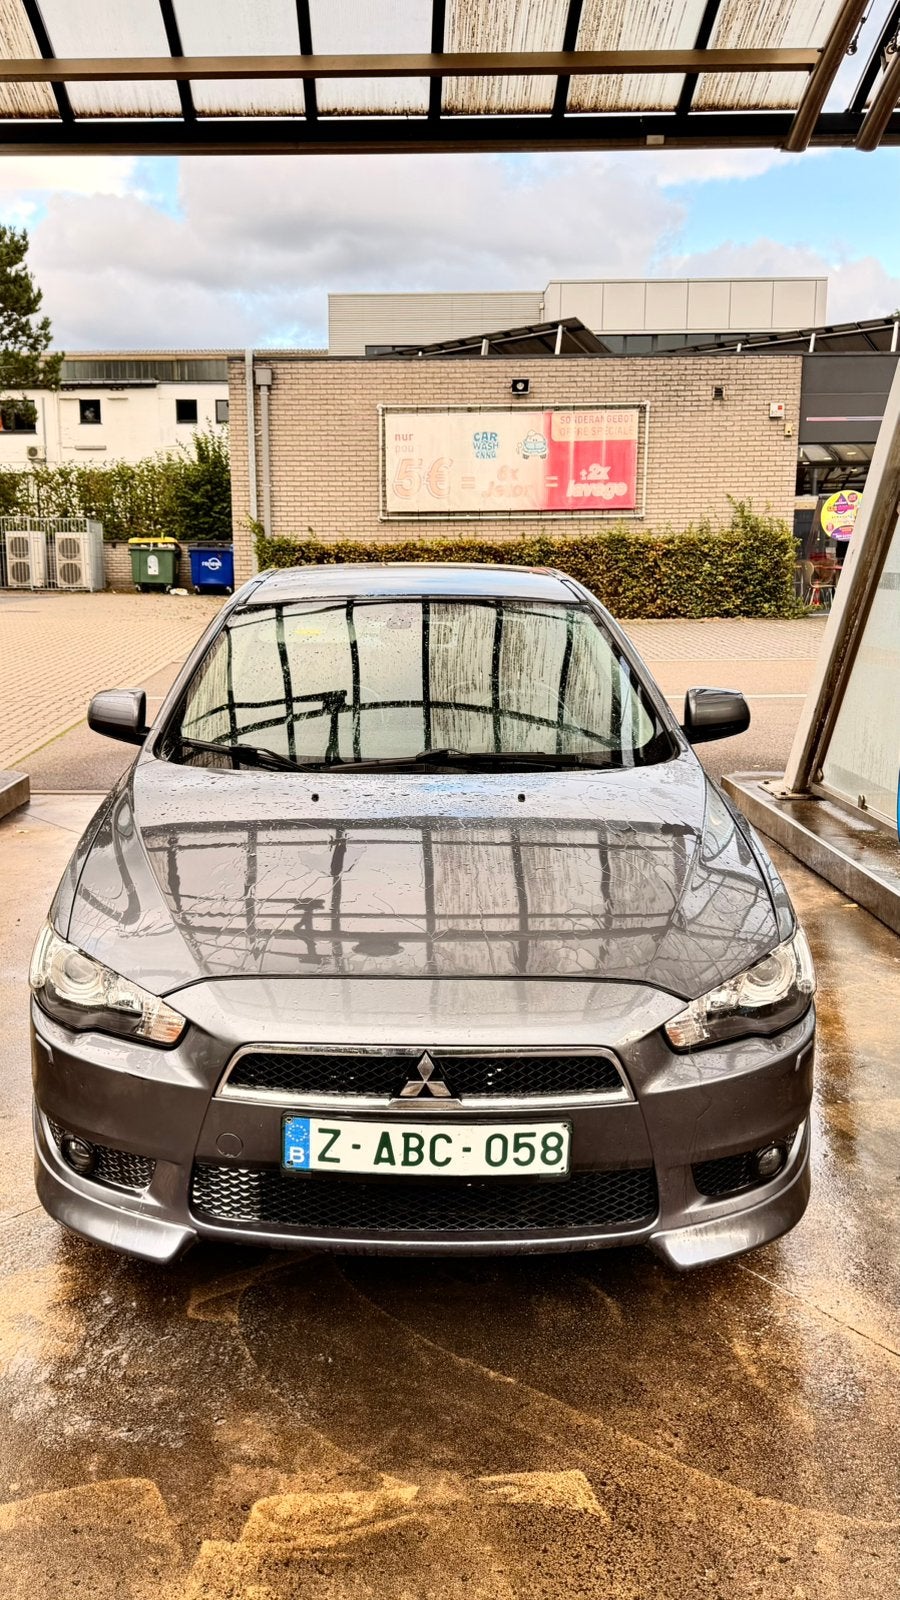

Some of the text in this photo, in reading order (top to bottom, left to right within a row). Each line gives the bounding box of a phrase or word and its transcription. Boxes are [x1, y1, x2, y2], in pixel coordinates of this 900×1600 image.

[474, 432, 498, 441] CAR
[395, 444, 416, 456] pou
[473, 441, 499, 450] WASH
[392, 457, 453, 500] 5€
[289, 1146, 305, 1164] B
